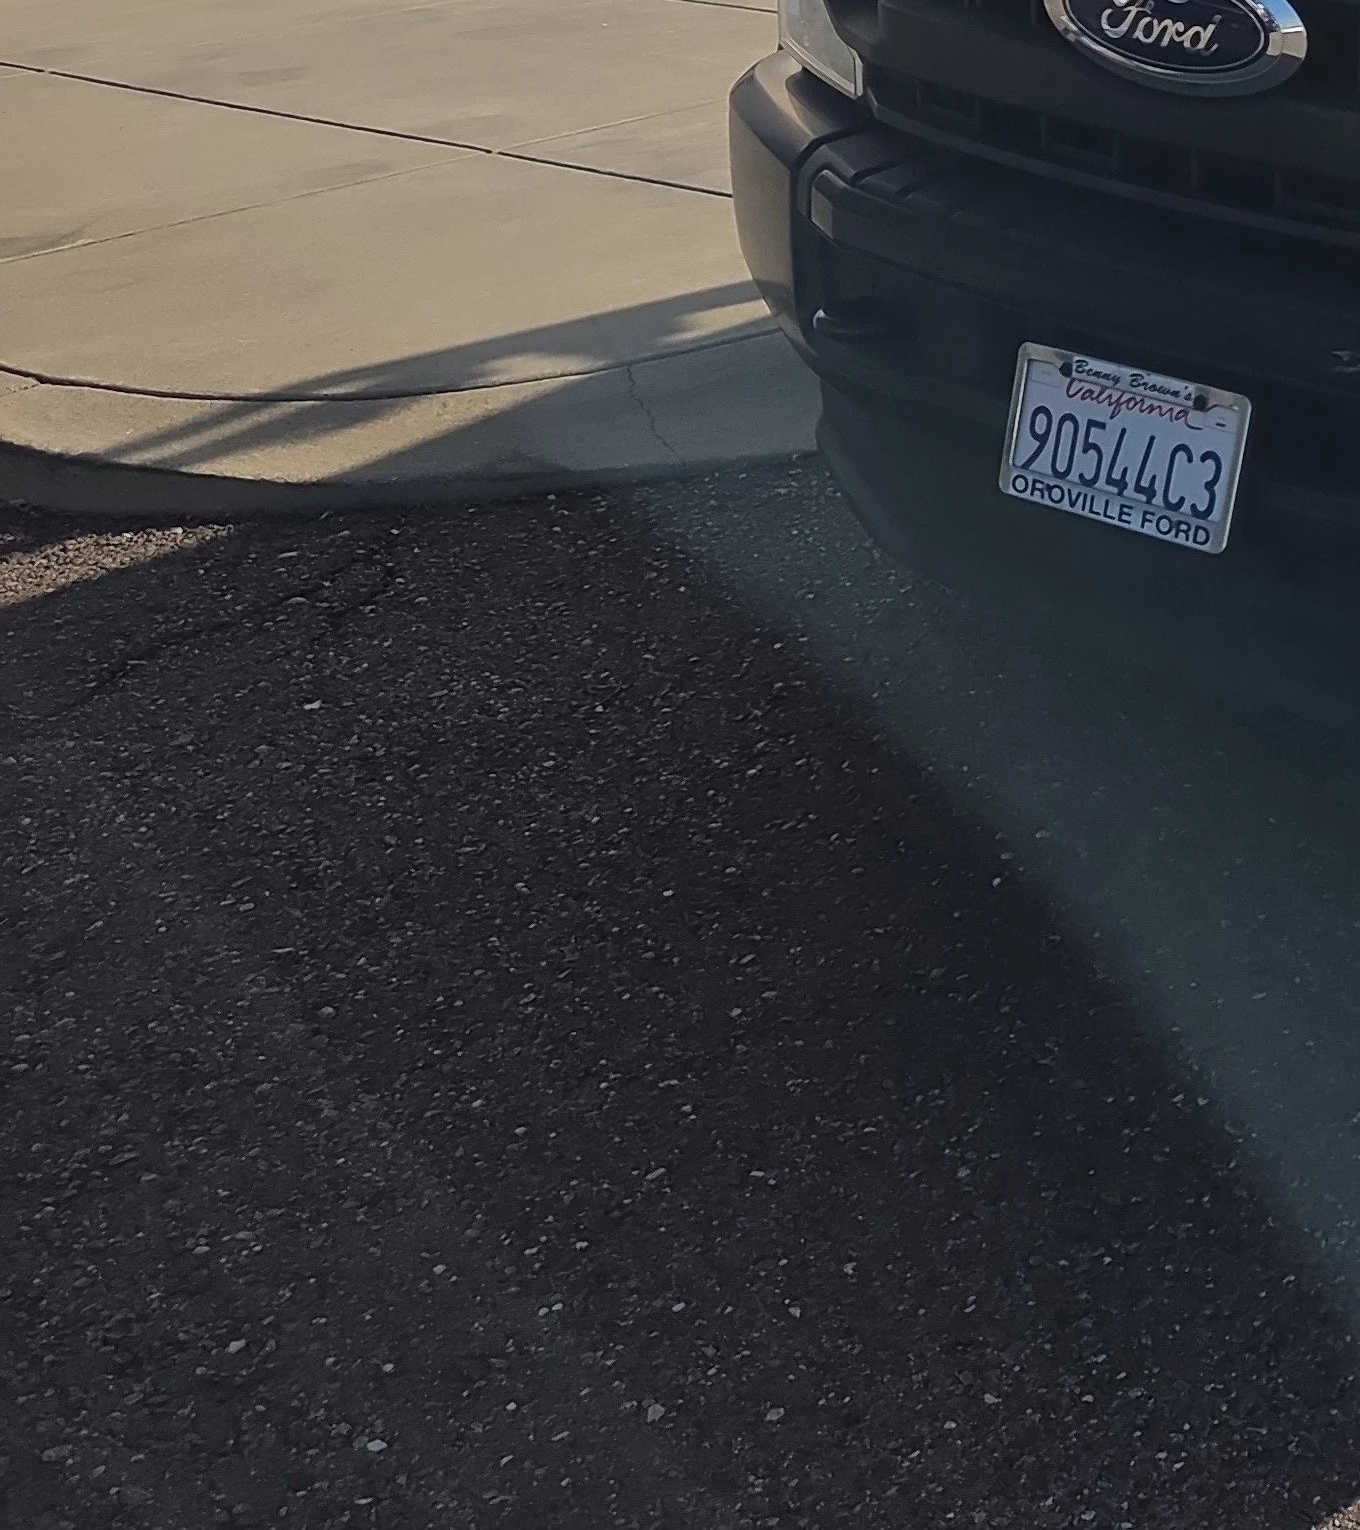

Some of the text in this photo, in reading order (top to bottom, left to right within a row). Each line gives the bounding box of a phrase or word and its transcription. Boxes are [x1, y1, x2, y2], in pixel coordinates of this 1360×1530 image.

[1065, 378, 1205, 431] California
[1074, 359, 1193, 402] Benny Brown's
[1020, 405, 1223, 521] 90544C3
[1011, 474, 1210, 547] OROVILLE FORD
